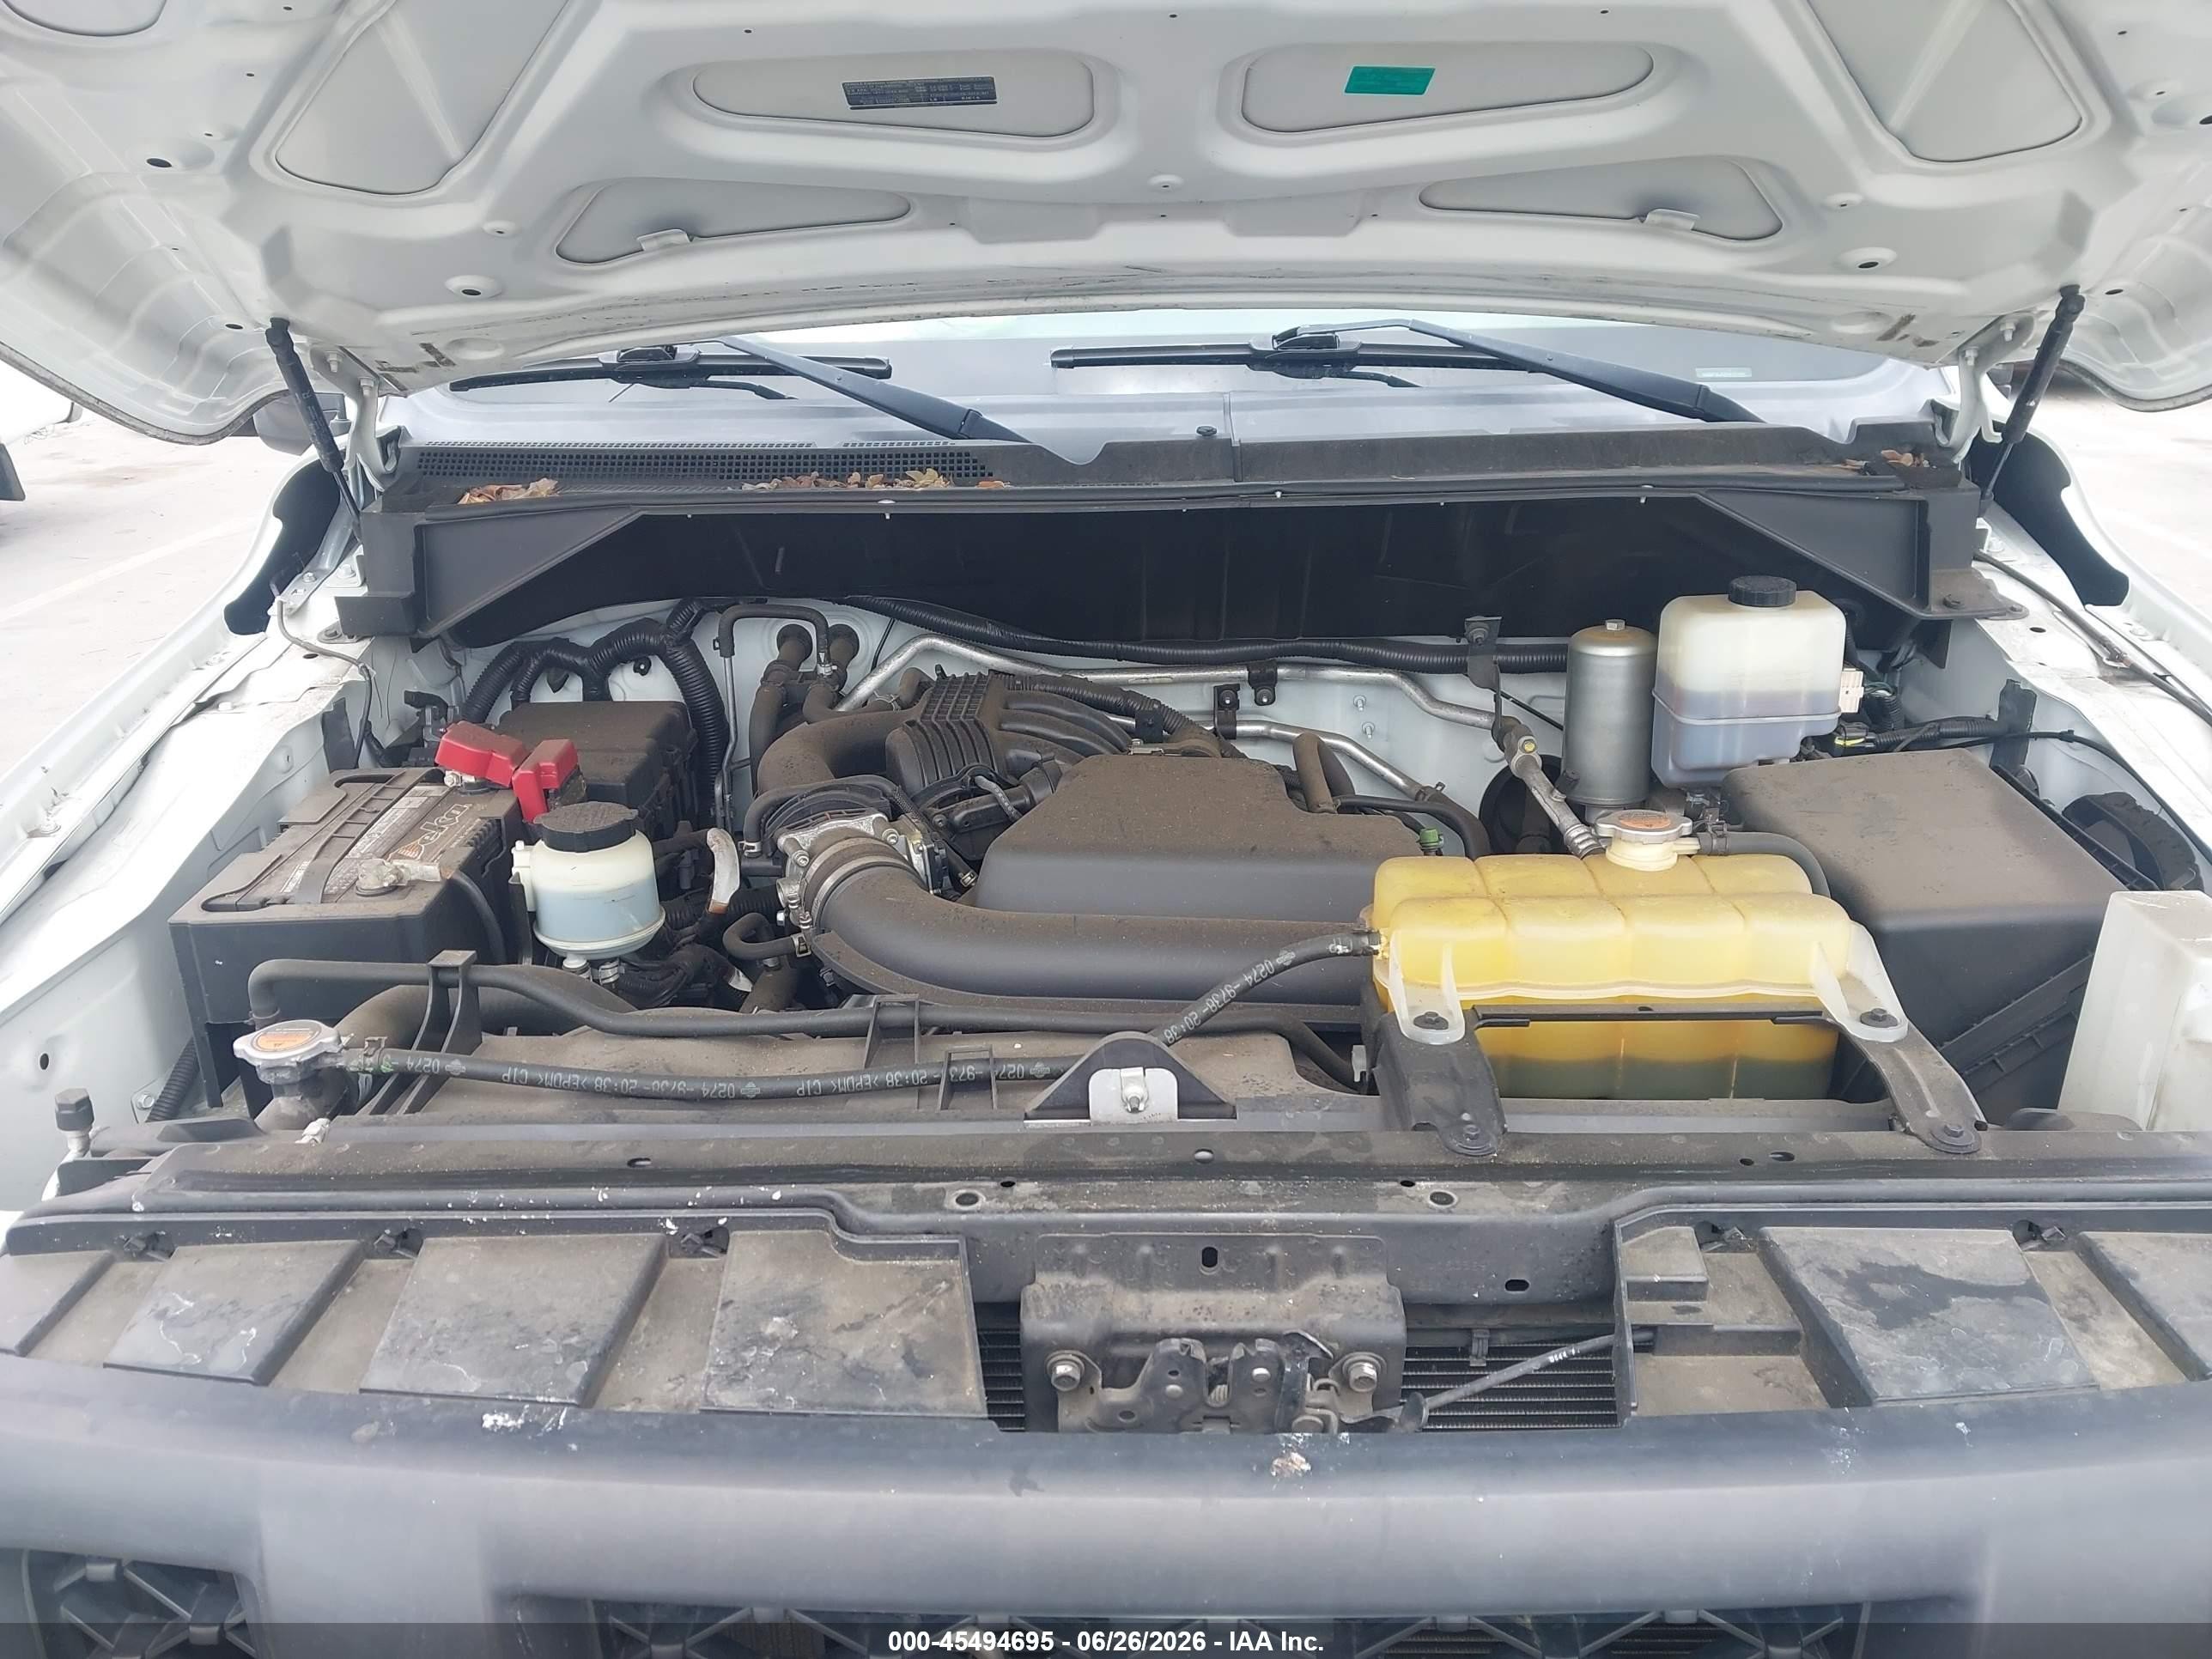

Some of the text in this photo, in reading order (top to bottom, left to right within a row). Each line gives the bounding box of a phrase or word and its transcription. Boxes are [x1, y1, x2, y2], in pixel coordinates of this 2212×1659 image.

[1243, 959, 1276, 987] 0274
[1202, 982, 1242, 1014] -9738-
[1164, 1011, 1202, 1045] 20:38
[406, 1055, 441, 1074] 0274
[501, 1066, 528, 1085] CIP
[886, 1073, 928, 1087] 20:38
[701, 1082, 735, 1098] 0274
[796, 1079, 822, 1097] CIP
